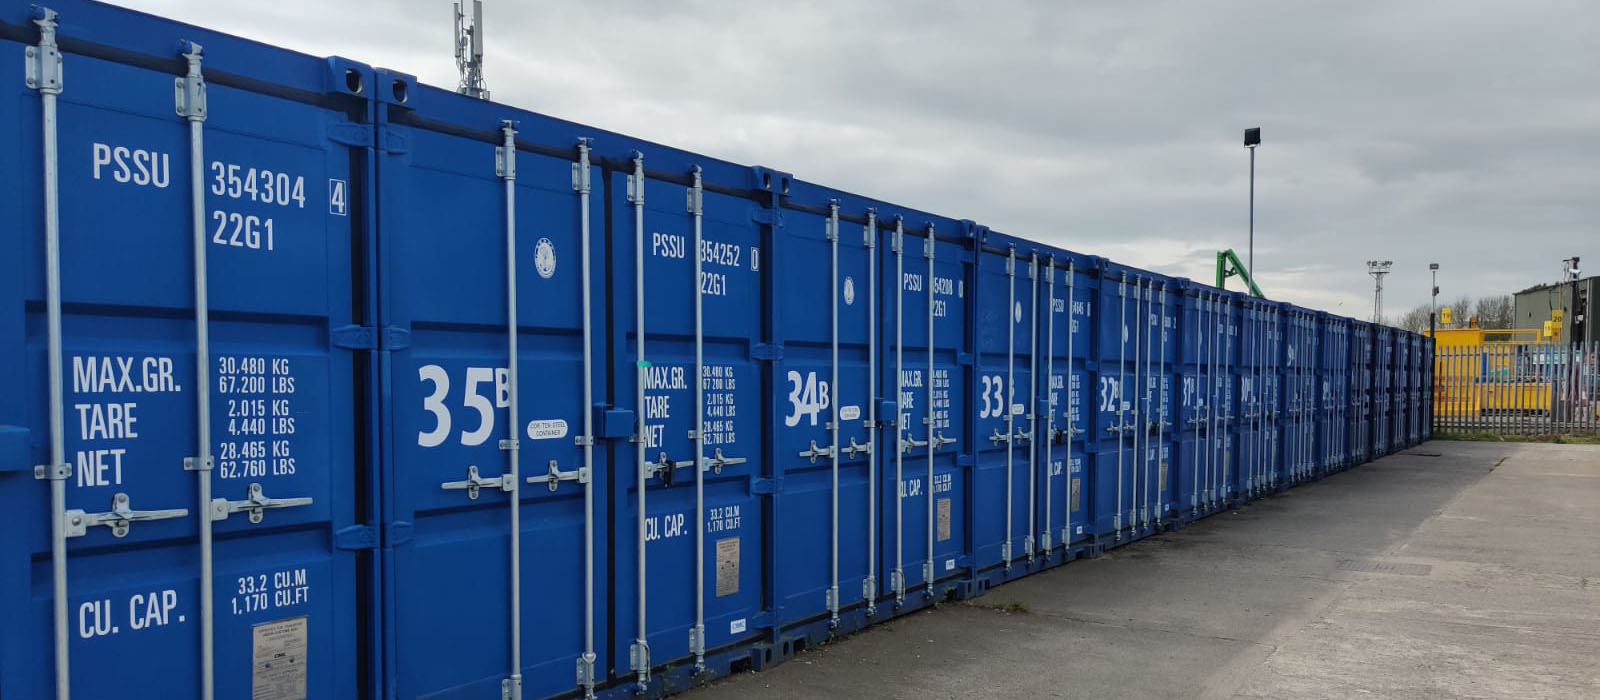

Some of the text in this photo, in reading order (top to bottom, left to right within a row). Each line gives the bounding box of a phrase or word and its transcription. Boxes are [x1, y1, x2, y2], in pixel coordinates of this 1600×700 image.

[94, 143, 344, 213] PSSU 354304 4
[213, 211, 273, 250] 22G1
[653, 233, 684, 258] PSSU
[752, 249, 758, 269] 0
[701, 271, 725, 295] 22G1
[904, 273, 921, 291] PSSU
[73, 357, 180, 392] MAX.GR.
[273, 359, 288, 374] KG
[273, 377, 294, 393] LBS
[644, 396, 669, 418] TARE
[902, 392, 913, 408] ARE
[75, 403, 137, 440] TARE
[273, 400, 288, 415] KG
[273, 418, 294, 434] LBS
[902, 413, 910, 429] ET
[644, 425, 664, 449] NET
[78, 449, 125, 487] NET
[273, 440, 289, 456] KG
[273, 458, 295, 475] LBS
[645, 506, 740, 541] CU. CAP. 33.2 CU.M
[726, 516, 740, 529] CU.FT
[80, 569, 306, 638] CU. CAP. 33.2 CU.M
[275, 585, 308, 606] CU.FT
